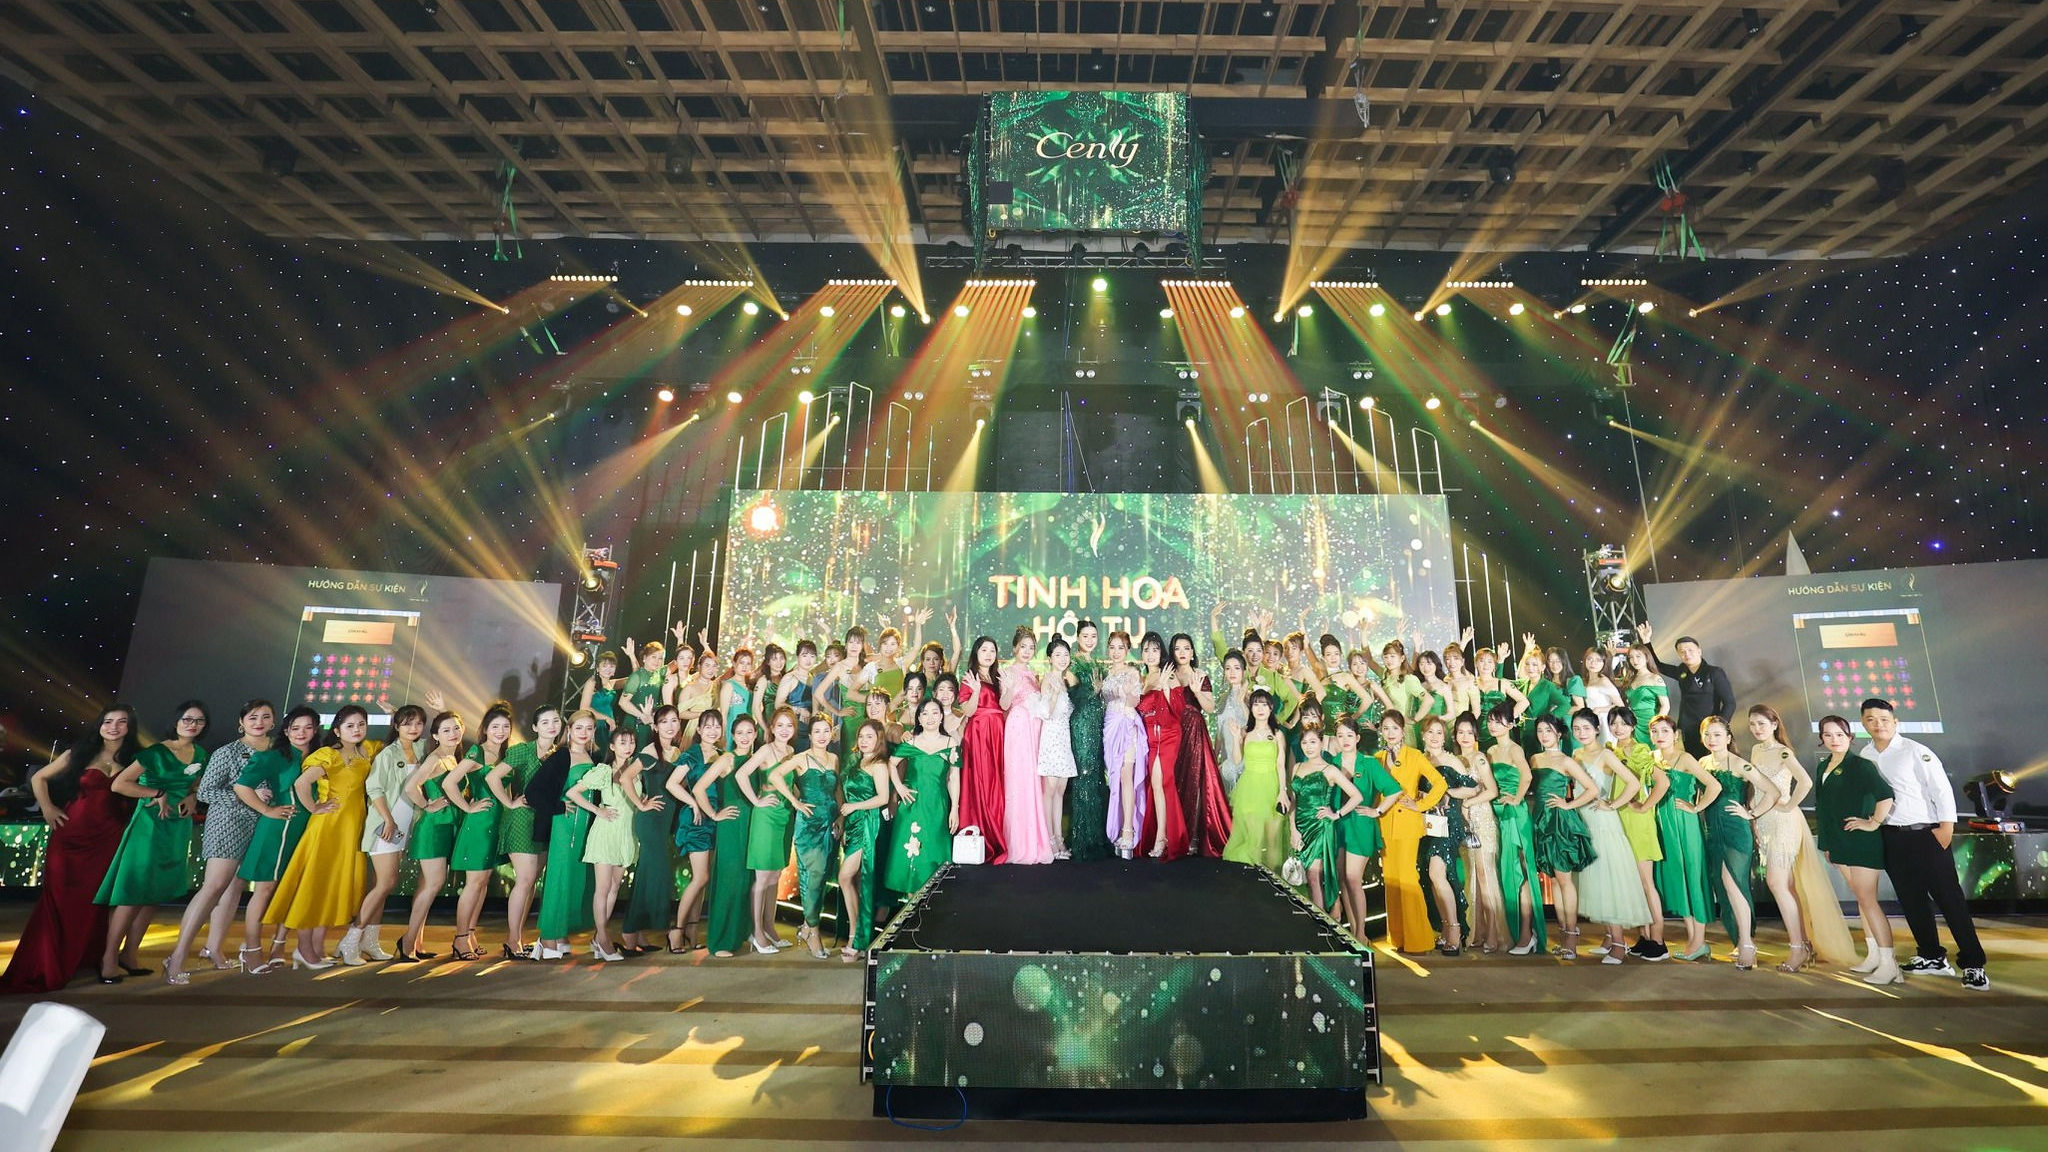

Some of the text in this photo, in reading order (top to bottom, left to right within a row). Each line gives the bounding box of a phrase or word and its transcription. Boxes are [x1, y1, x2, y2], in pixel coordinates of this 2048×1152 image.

[1036, 129, 1139, 169] Cenly
[988, 575, 1190, 609] TINH HOA
[1033, 610, 1090, 650] HỘ
